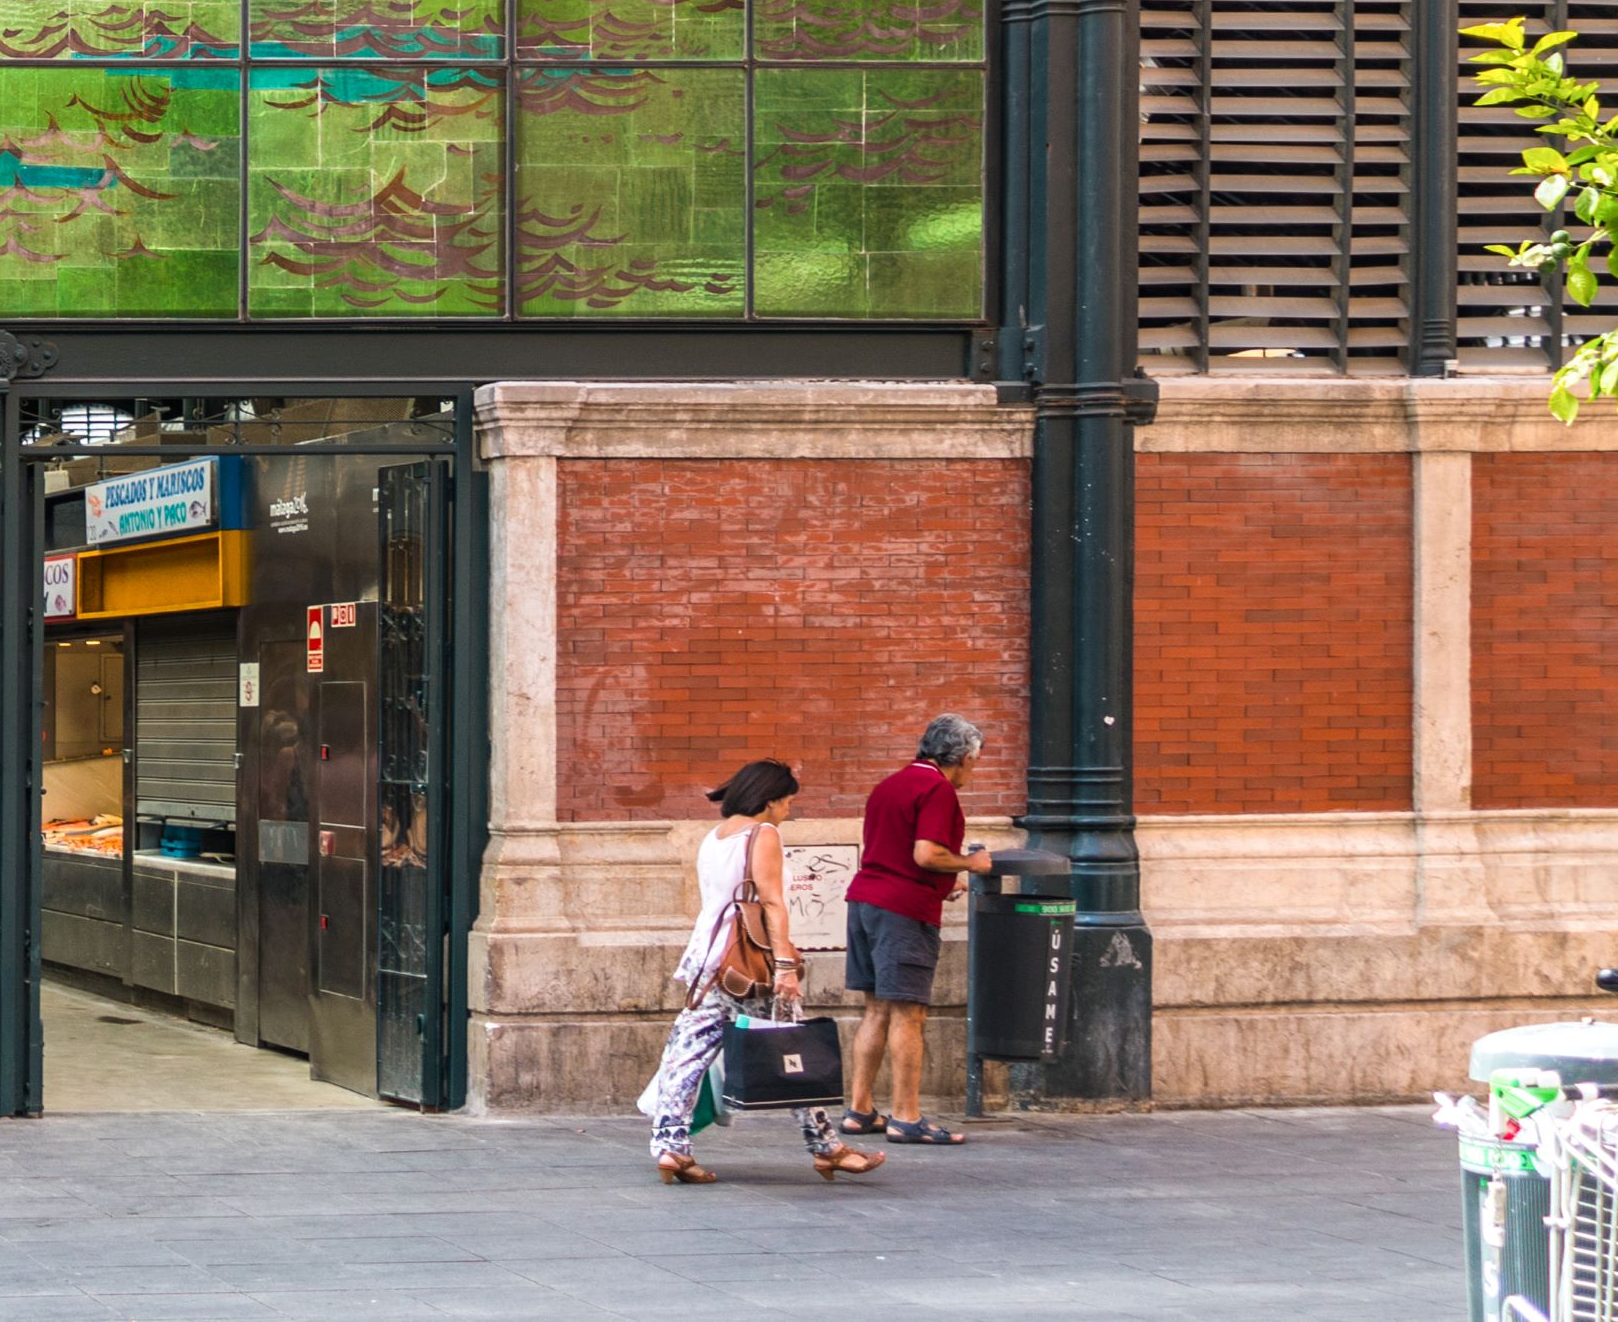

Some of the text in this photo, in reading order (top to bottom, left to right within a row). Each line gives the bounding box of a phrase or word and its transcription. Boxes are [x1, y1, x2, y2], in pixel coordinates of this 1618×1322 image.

[105, 466, 205, 509] PESCADOS Y MARISCOS
[119, 501, 187, 536] ANTONIO Y PACO
